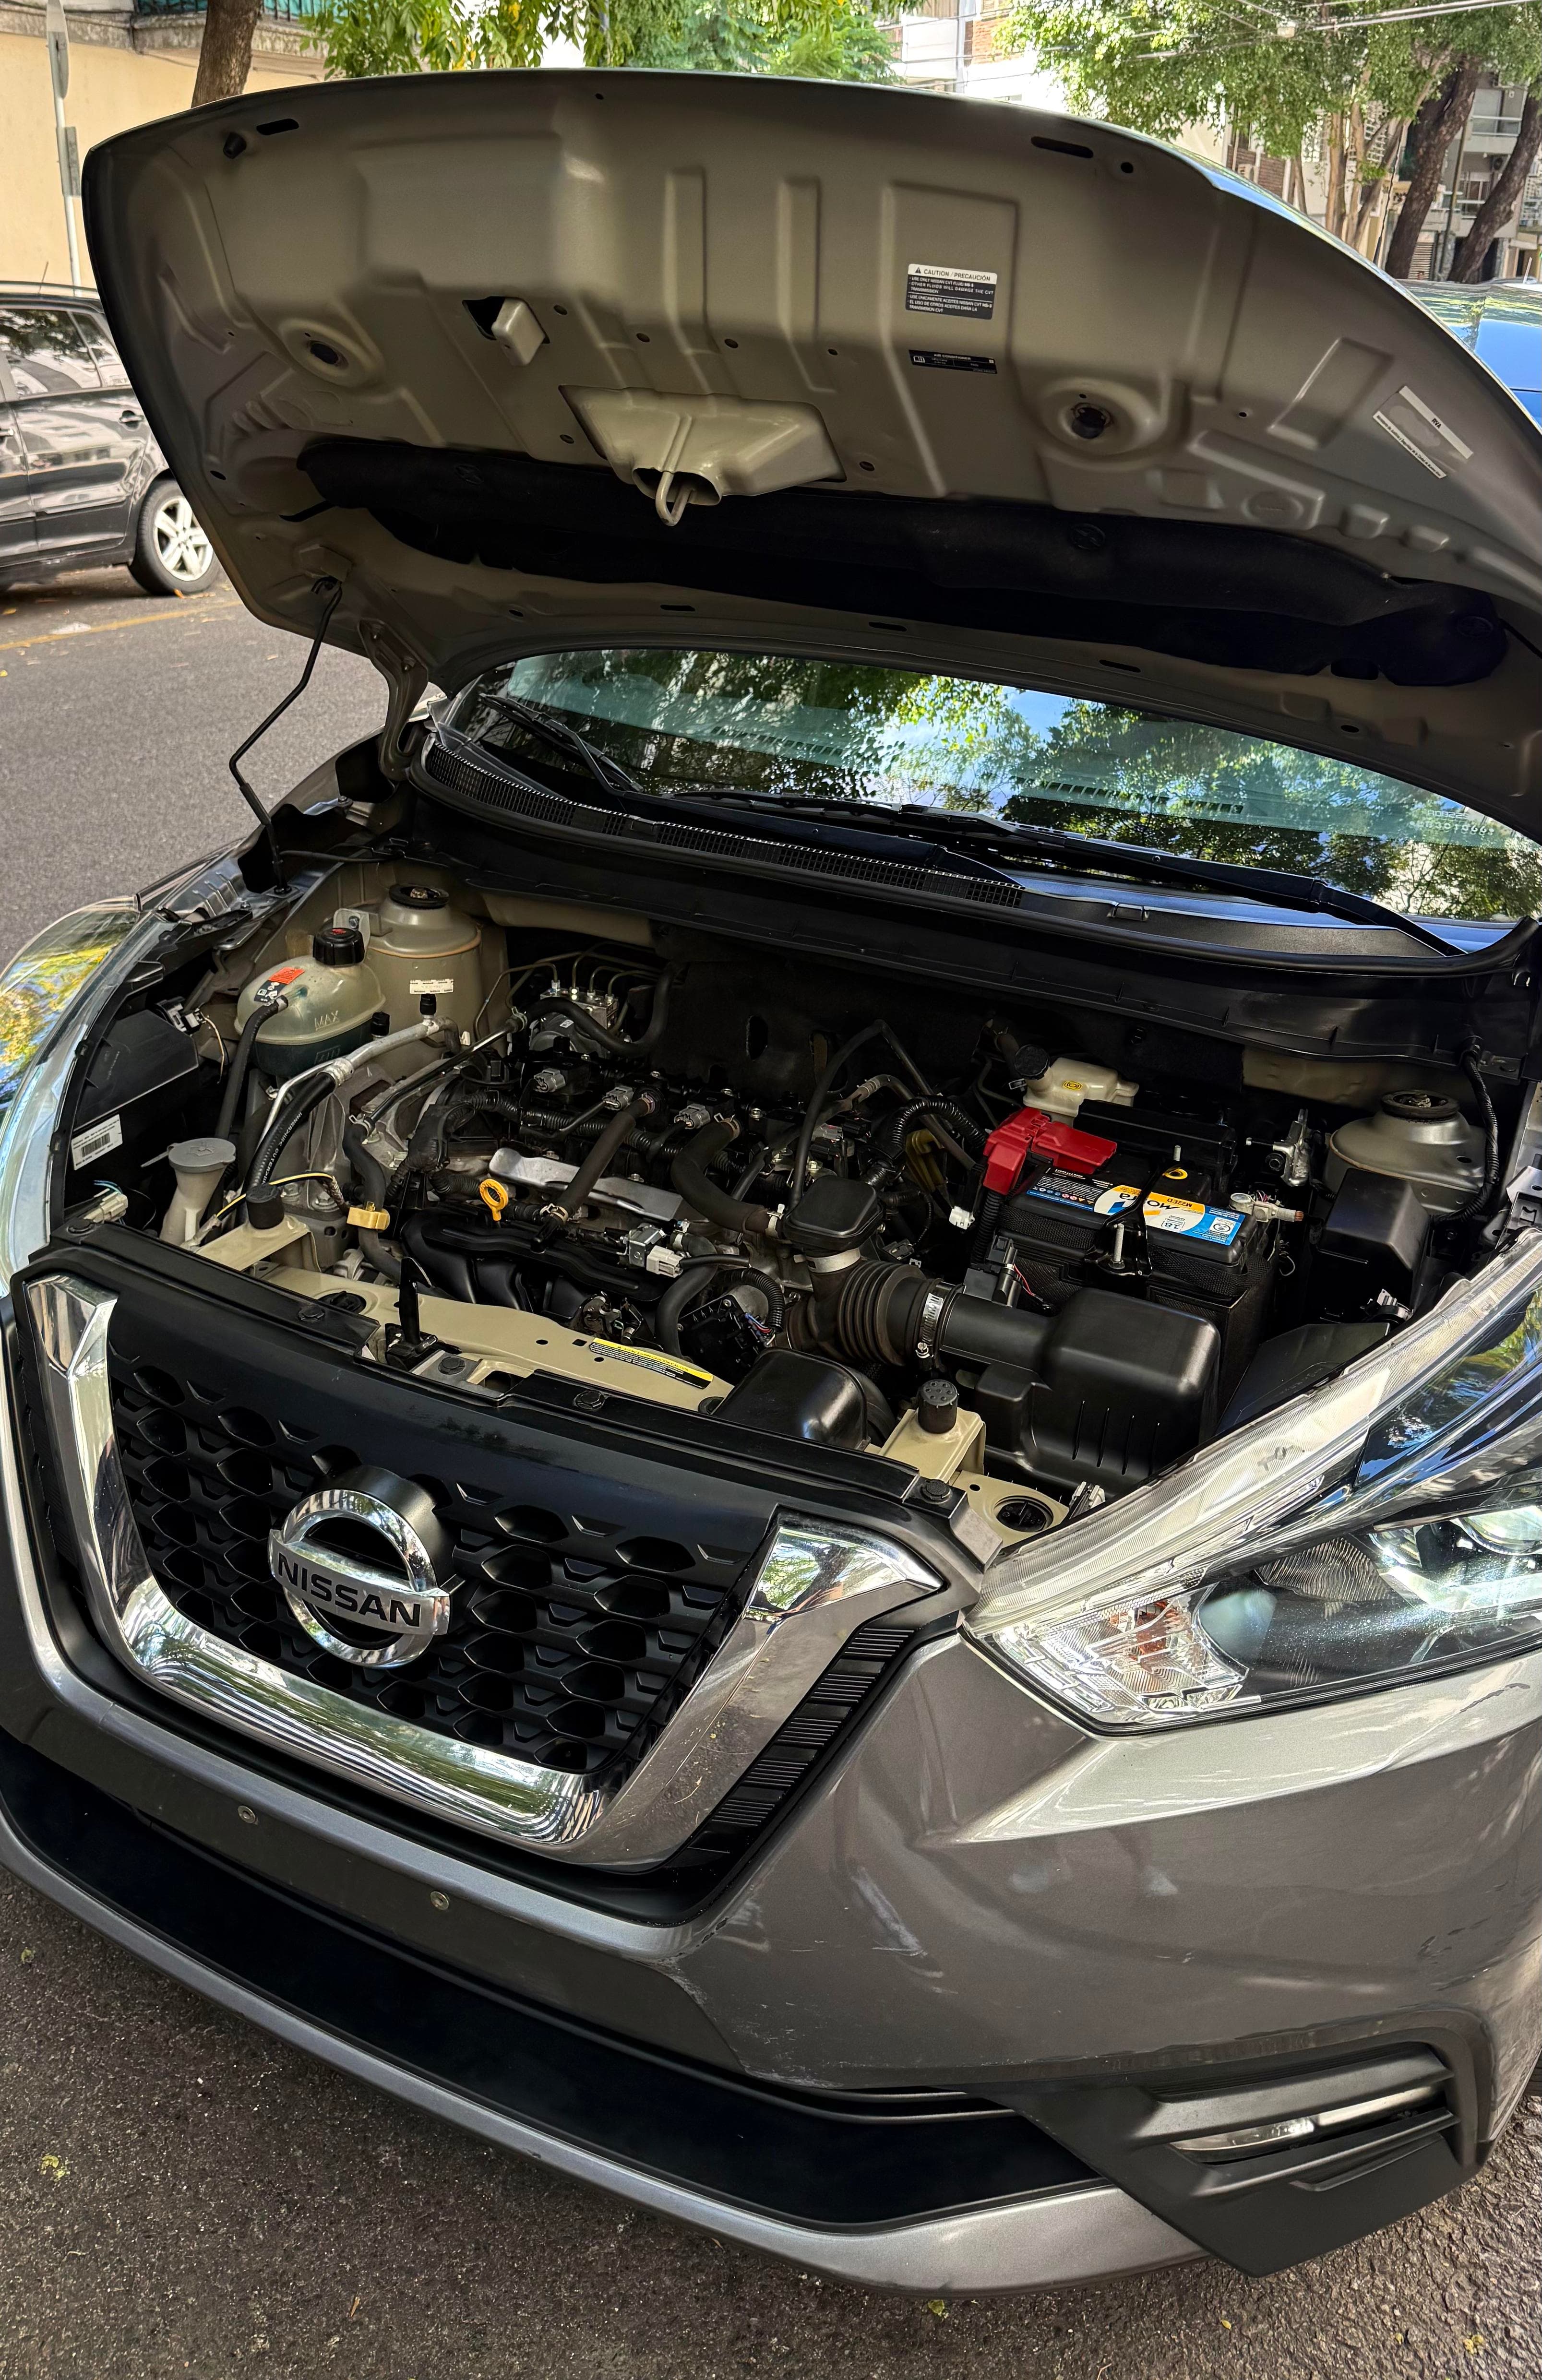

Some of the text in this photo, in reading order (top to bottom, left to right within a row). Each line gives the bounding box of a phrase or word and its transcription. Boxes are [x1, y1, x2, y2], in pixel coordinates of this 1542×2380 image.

[954, 272, 991, 281] PRECAUCIÓN
[1432, 418, 1442, 428] RVA
[315, 1010, 339, 1029] MAX
[1167, 1198, 1193, 1208] M22ED
[278, 1553, 421, 1627] NISSAN
